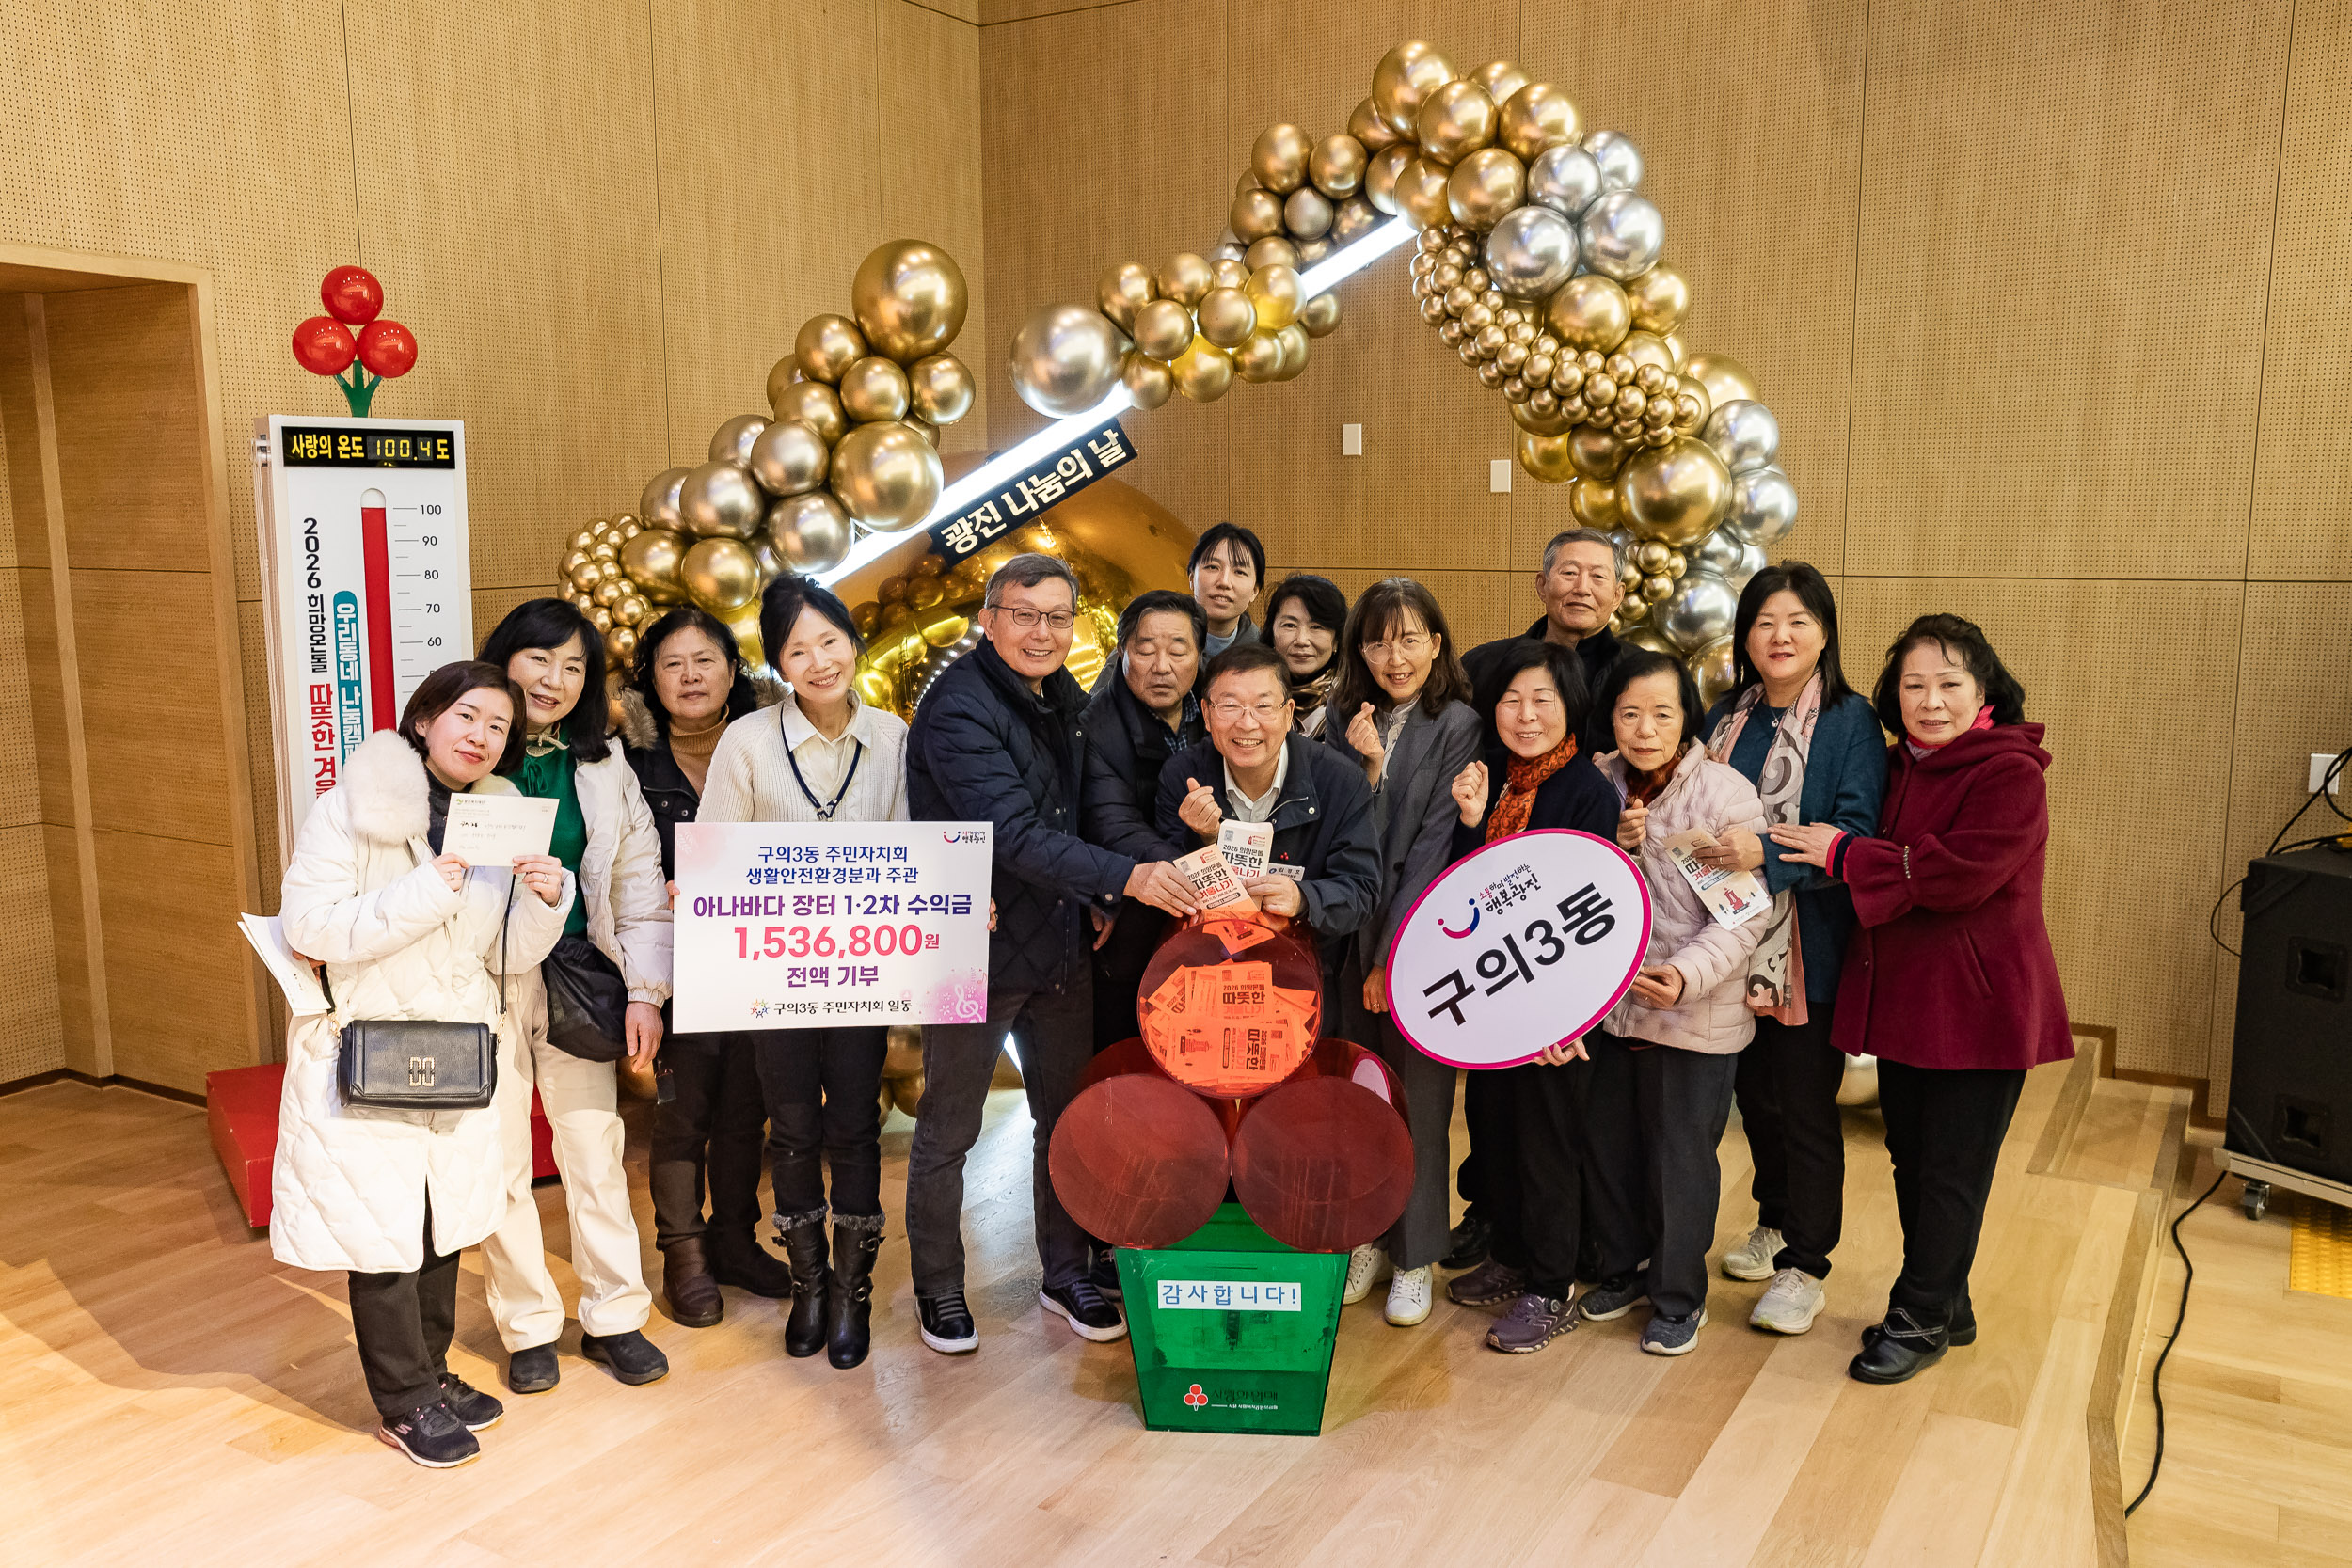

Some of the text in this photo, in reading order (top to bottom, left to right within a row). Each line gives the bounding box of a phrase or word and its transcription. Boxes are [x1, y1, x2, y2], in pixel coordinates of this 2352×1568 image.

[291, 434, 450, 461] 사랑의 온도 100.4 도
[941, 428, 1127, 554] 광진 나눔의 날
[421, 504, 442, 515] 100
[422, 536, 437, 546] 90
[303, 517, 323, 589] 2026
[424, 570, 439, 579] 80
[426, 604, 440, 613] 70
[307, 594, 328, 673] 희망온돌
[336, 603, 360, 682] 우리동네
[427, 637, 442, 646] 60
[310, 683, 336, 752] 따뜻한
[758, 846, 908, 863] 구의3동 주민자치회
[1222, 844, 1238, 852] 2026
[746, 867, 918, 885] 생활안전환경분과 주관
[1502, 863, 1532, 885] 발전하는
[1485, 873, 1541, 915] 행복광진
[693, 895, 972, 917] 아나바다 장터 1·2차 수익금
[734, 924, 939, 960] 1,536,800원
[1422, 882, 1615, 1027] 구의3동
[787, 965, 879, 988] 전액 기부
[773, 999, 913, 1015] 구의3동 주민자치회 일동
[1223, 991, 1265, 1005] 따뜻한
[1246, 1028, 1261, 1071] 따뜻한
[1162, 1284, 1296, 1306] 감사합니다!
